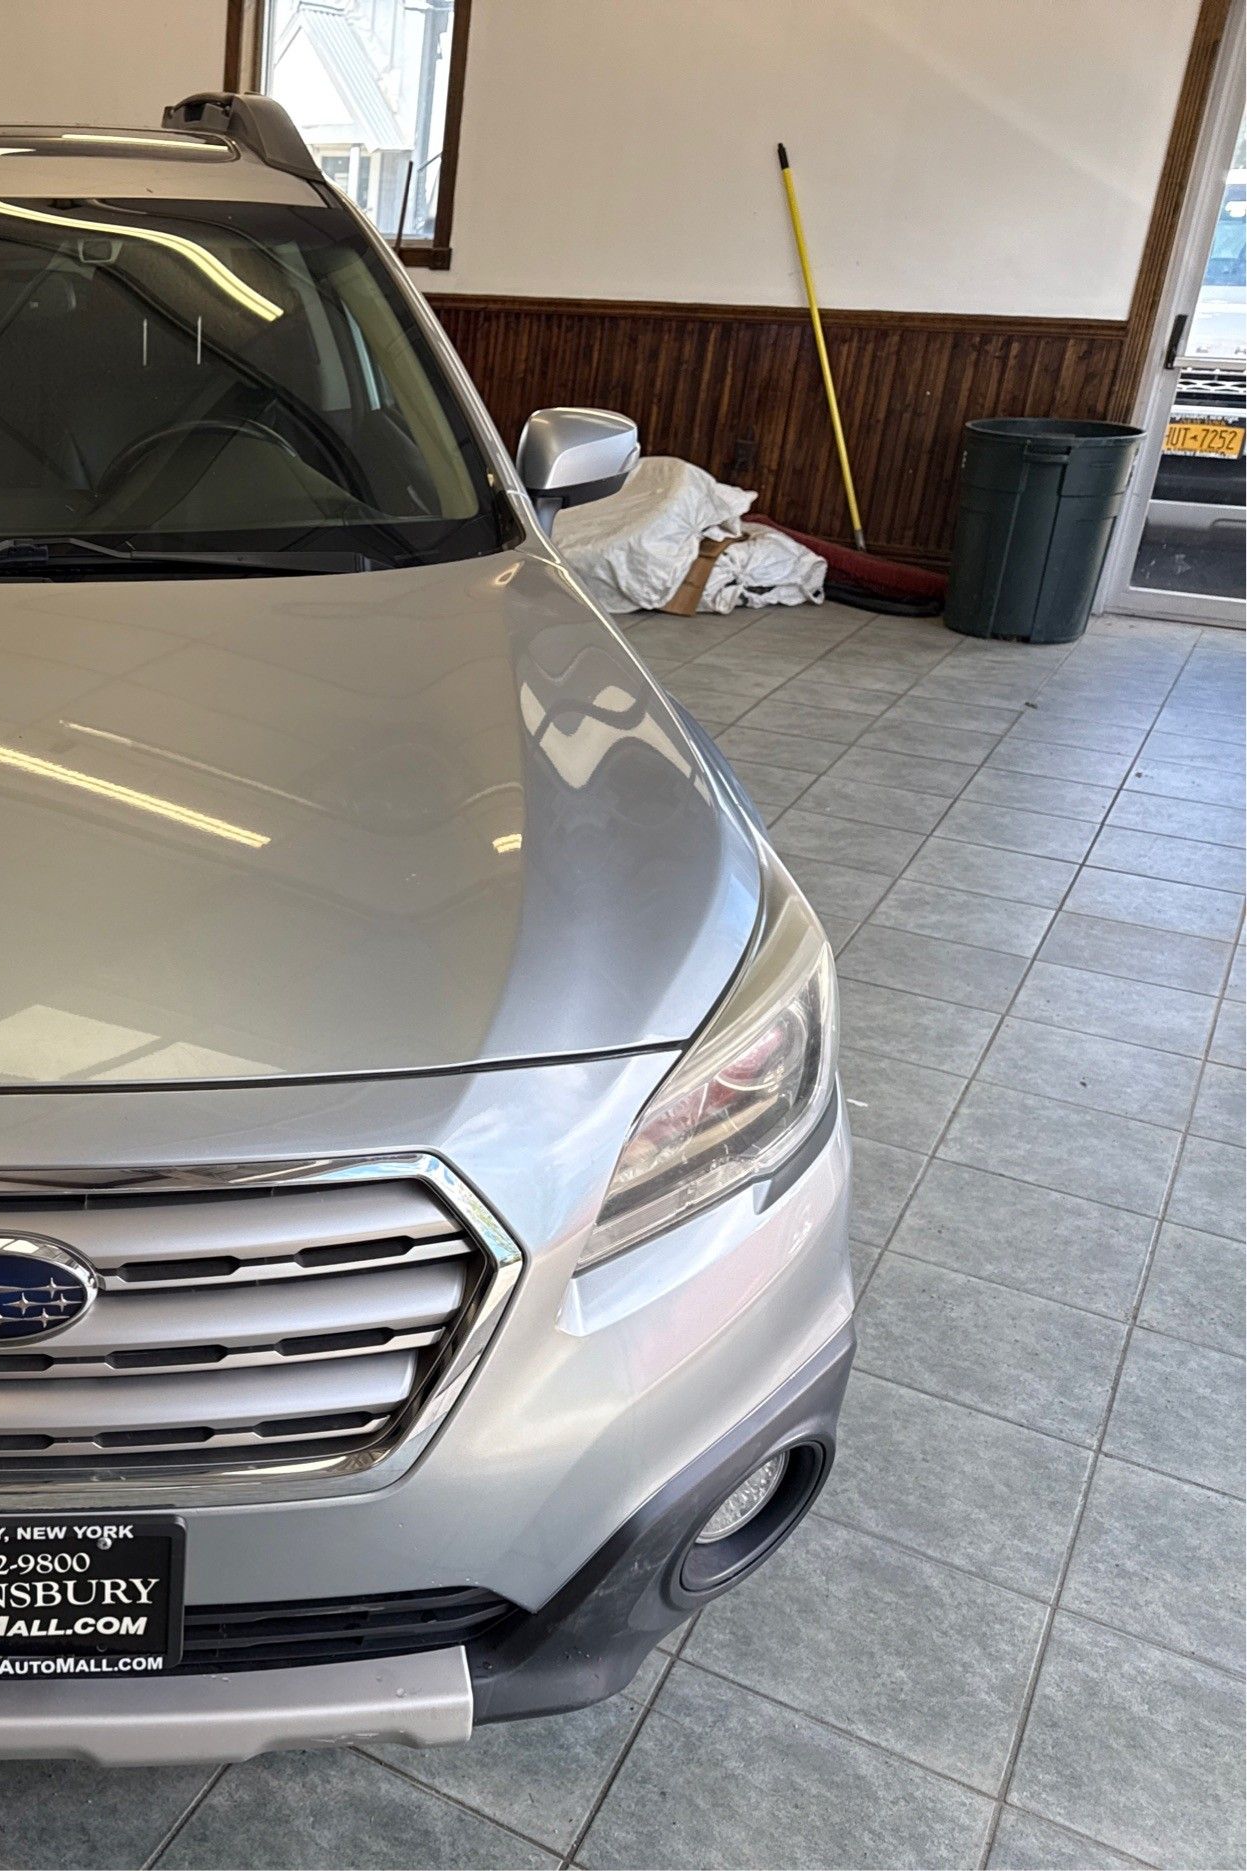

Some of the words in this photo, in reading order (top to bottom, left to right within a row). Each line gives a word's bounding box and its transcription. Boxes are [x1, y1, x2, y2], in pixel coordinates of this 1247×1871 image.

[1199, 428, 1238, 451] 7252
[16, 1525, 67, 1541] NEW
[73, 1525, 135, 1540] YORK
